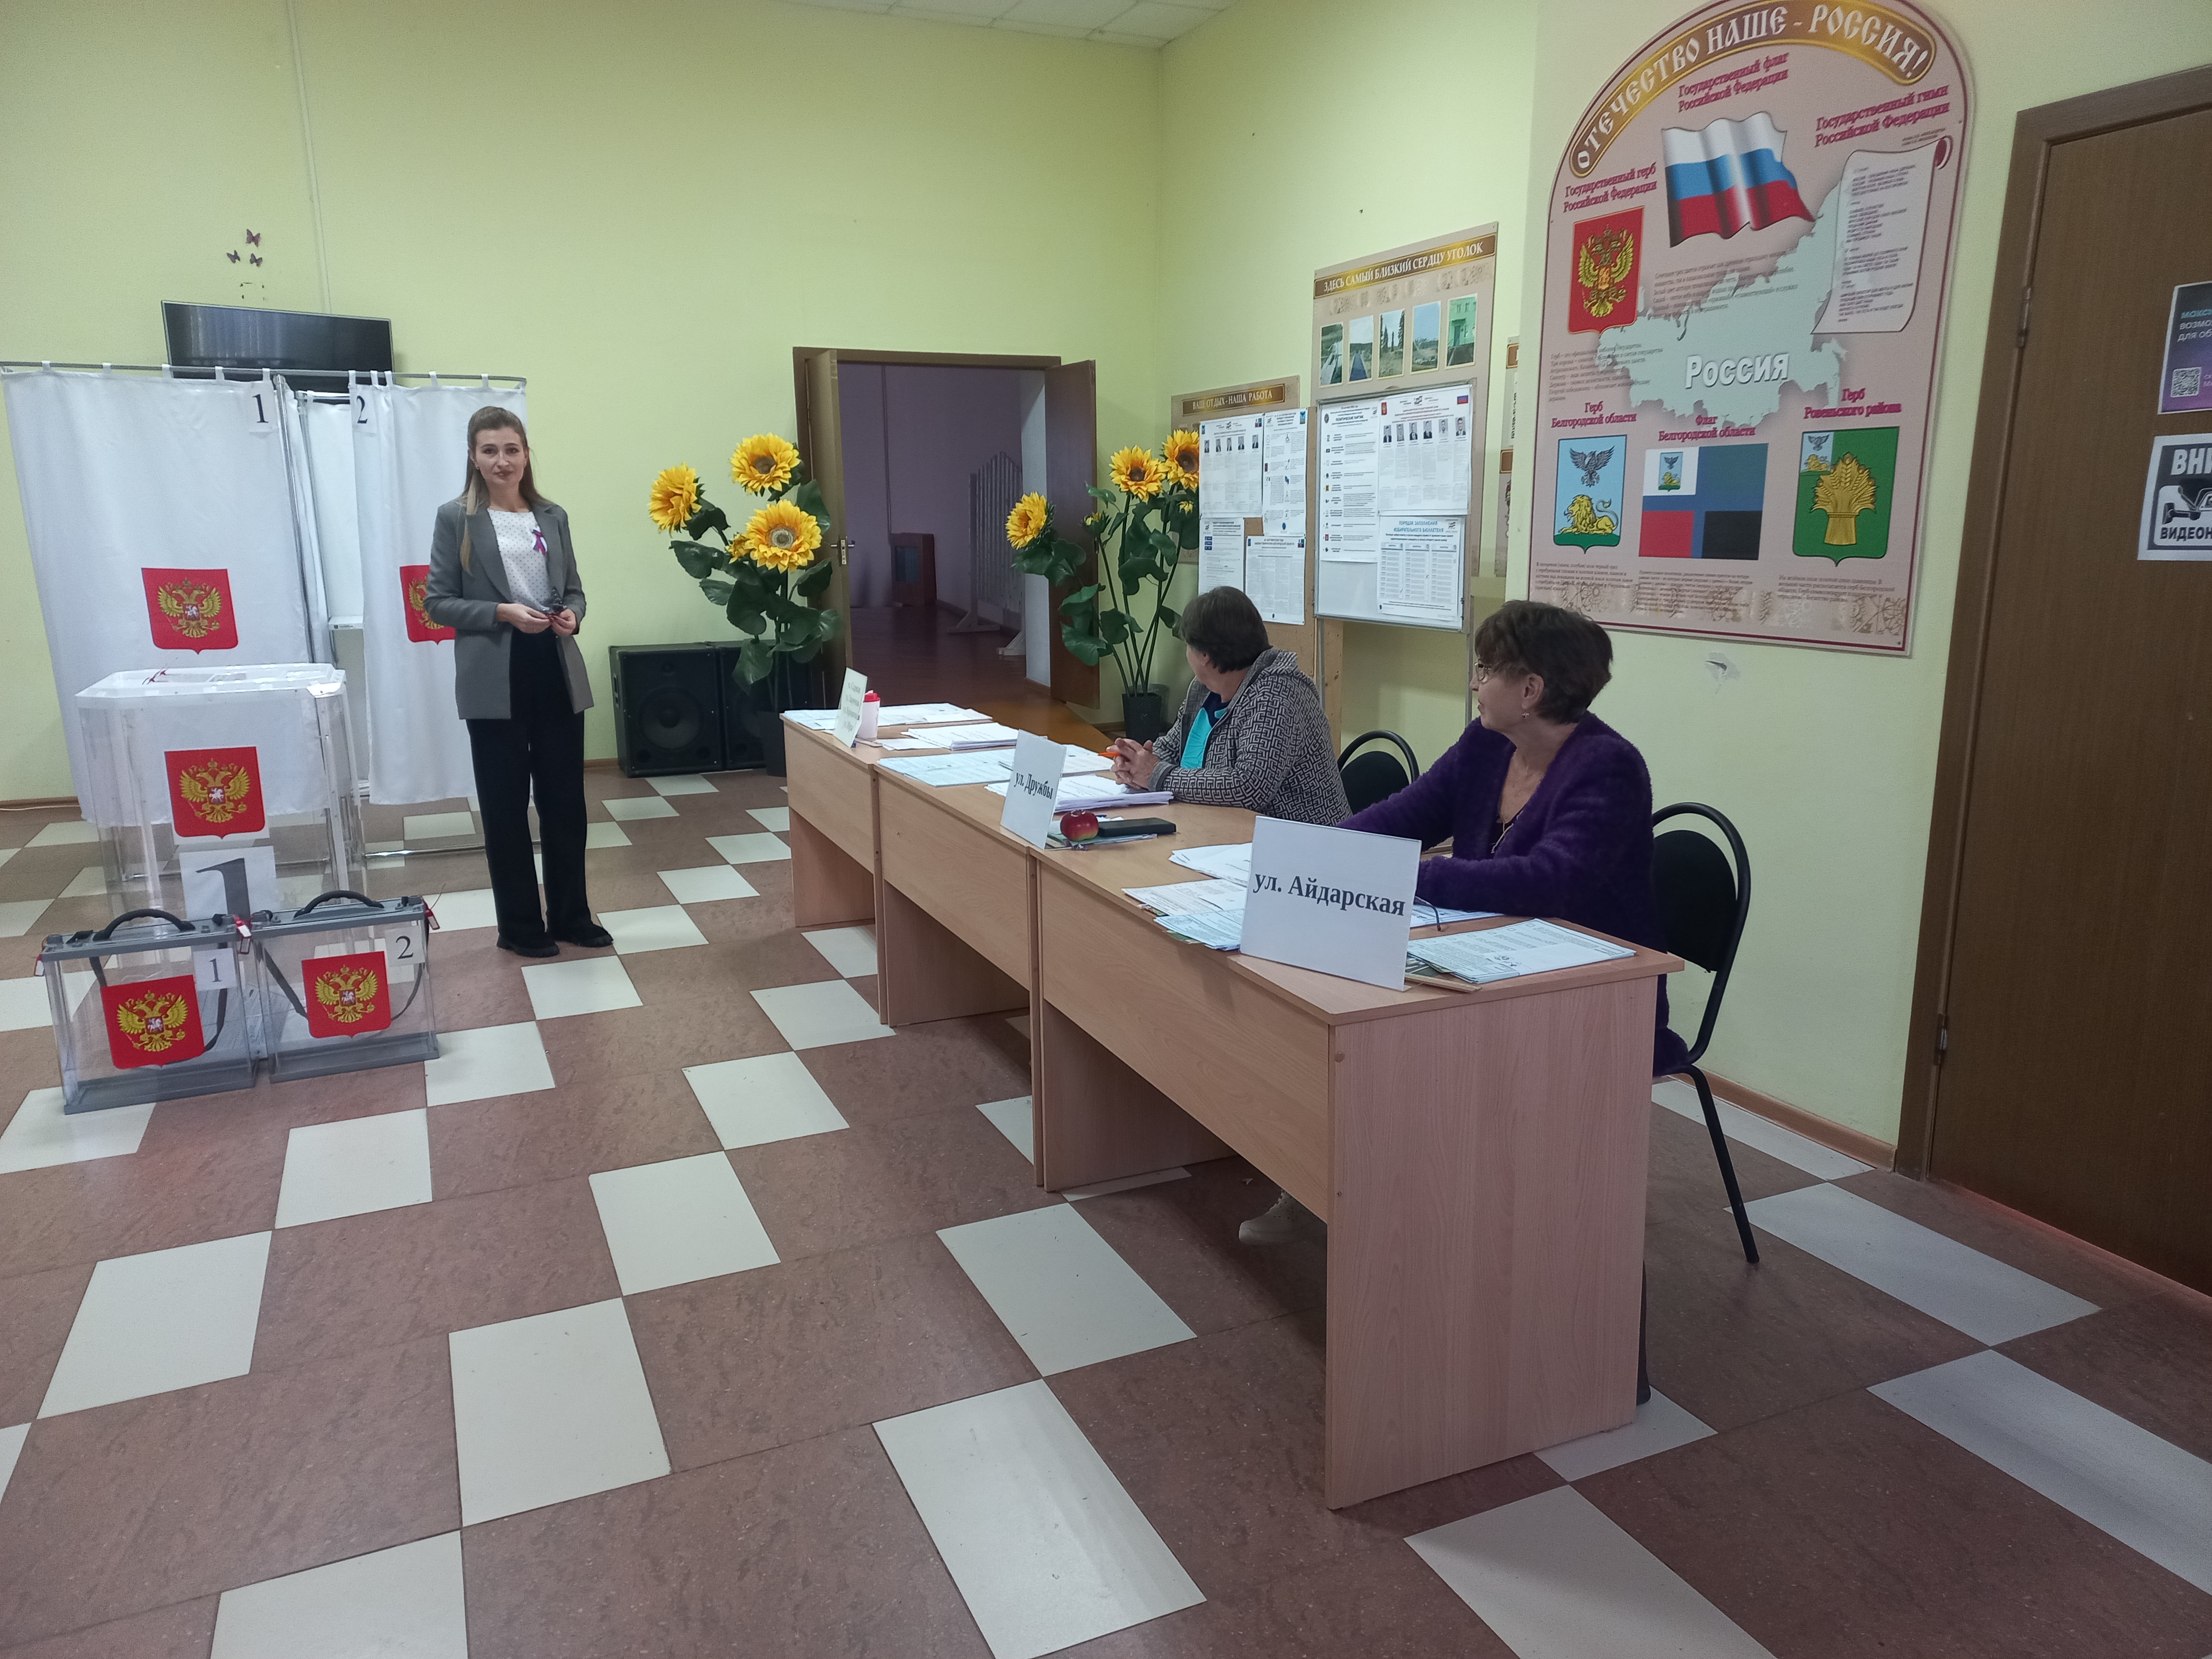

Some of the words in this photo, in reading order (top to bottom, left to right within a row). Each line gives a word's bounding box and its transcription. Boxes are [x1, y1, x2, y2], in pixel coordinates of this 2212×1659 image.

[1578, 37, 1700, 169] ОТЕЧЕСТВО
[1706, 6, 1788, 55] НАШЕ
[1808, 4, 1928, 78] РОССИЯ!
[1637, 162, 1657, 179] герб
[1324, 279, 1345, 293] ЗДЕСЬ
[1345, 269, 1373, 286] САМЫЙ
[1375, 259, 1411, 280] БЛИЗКИЙ
[1413, 252, 1444, 269] СЕРДЦУ
[1447, 242, 1483, 261] УГОЛОК
[2179, 320, 2212, 330] возмо
[2177, 332, 2198, 343] для
[1193, 400, 1205, 410] ВАШ
[1249, 390, 1272, 402] РАБОТА
[1841, 387, 1866, 403] Герб
[252, 394, 268, 423] 1
[356, 395, 367, 423] 2
[1584, 401, 1603, 414] Герб
[1551, 414, 1604, 429] Белгородской
[1605, 412, 1637, 423] области
[1696, 415, 1718, 427] Флаг
[1659, 427, 1717, 442] Белгородской
[1719, 425, 1756, 438] области
[1014, 773, 1024, 787] ул.
[1024, 774, 1053, 799] Дружбы
[195, 857, 251, 921] 1
[1252, 874, 1282, 893] ул.
[1288, 875, 1405, 916] Айдарская
[395, 936, 413, 960] 2
[209, 958, 221, 983] 1
